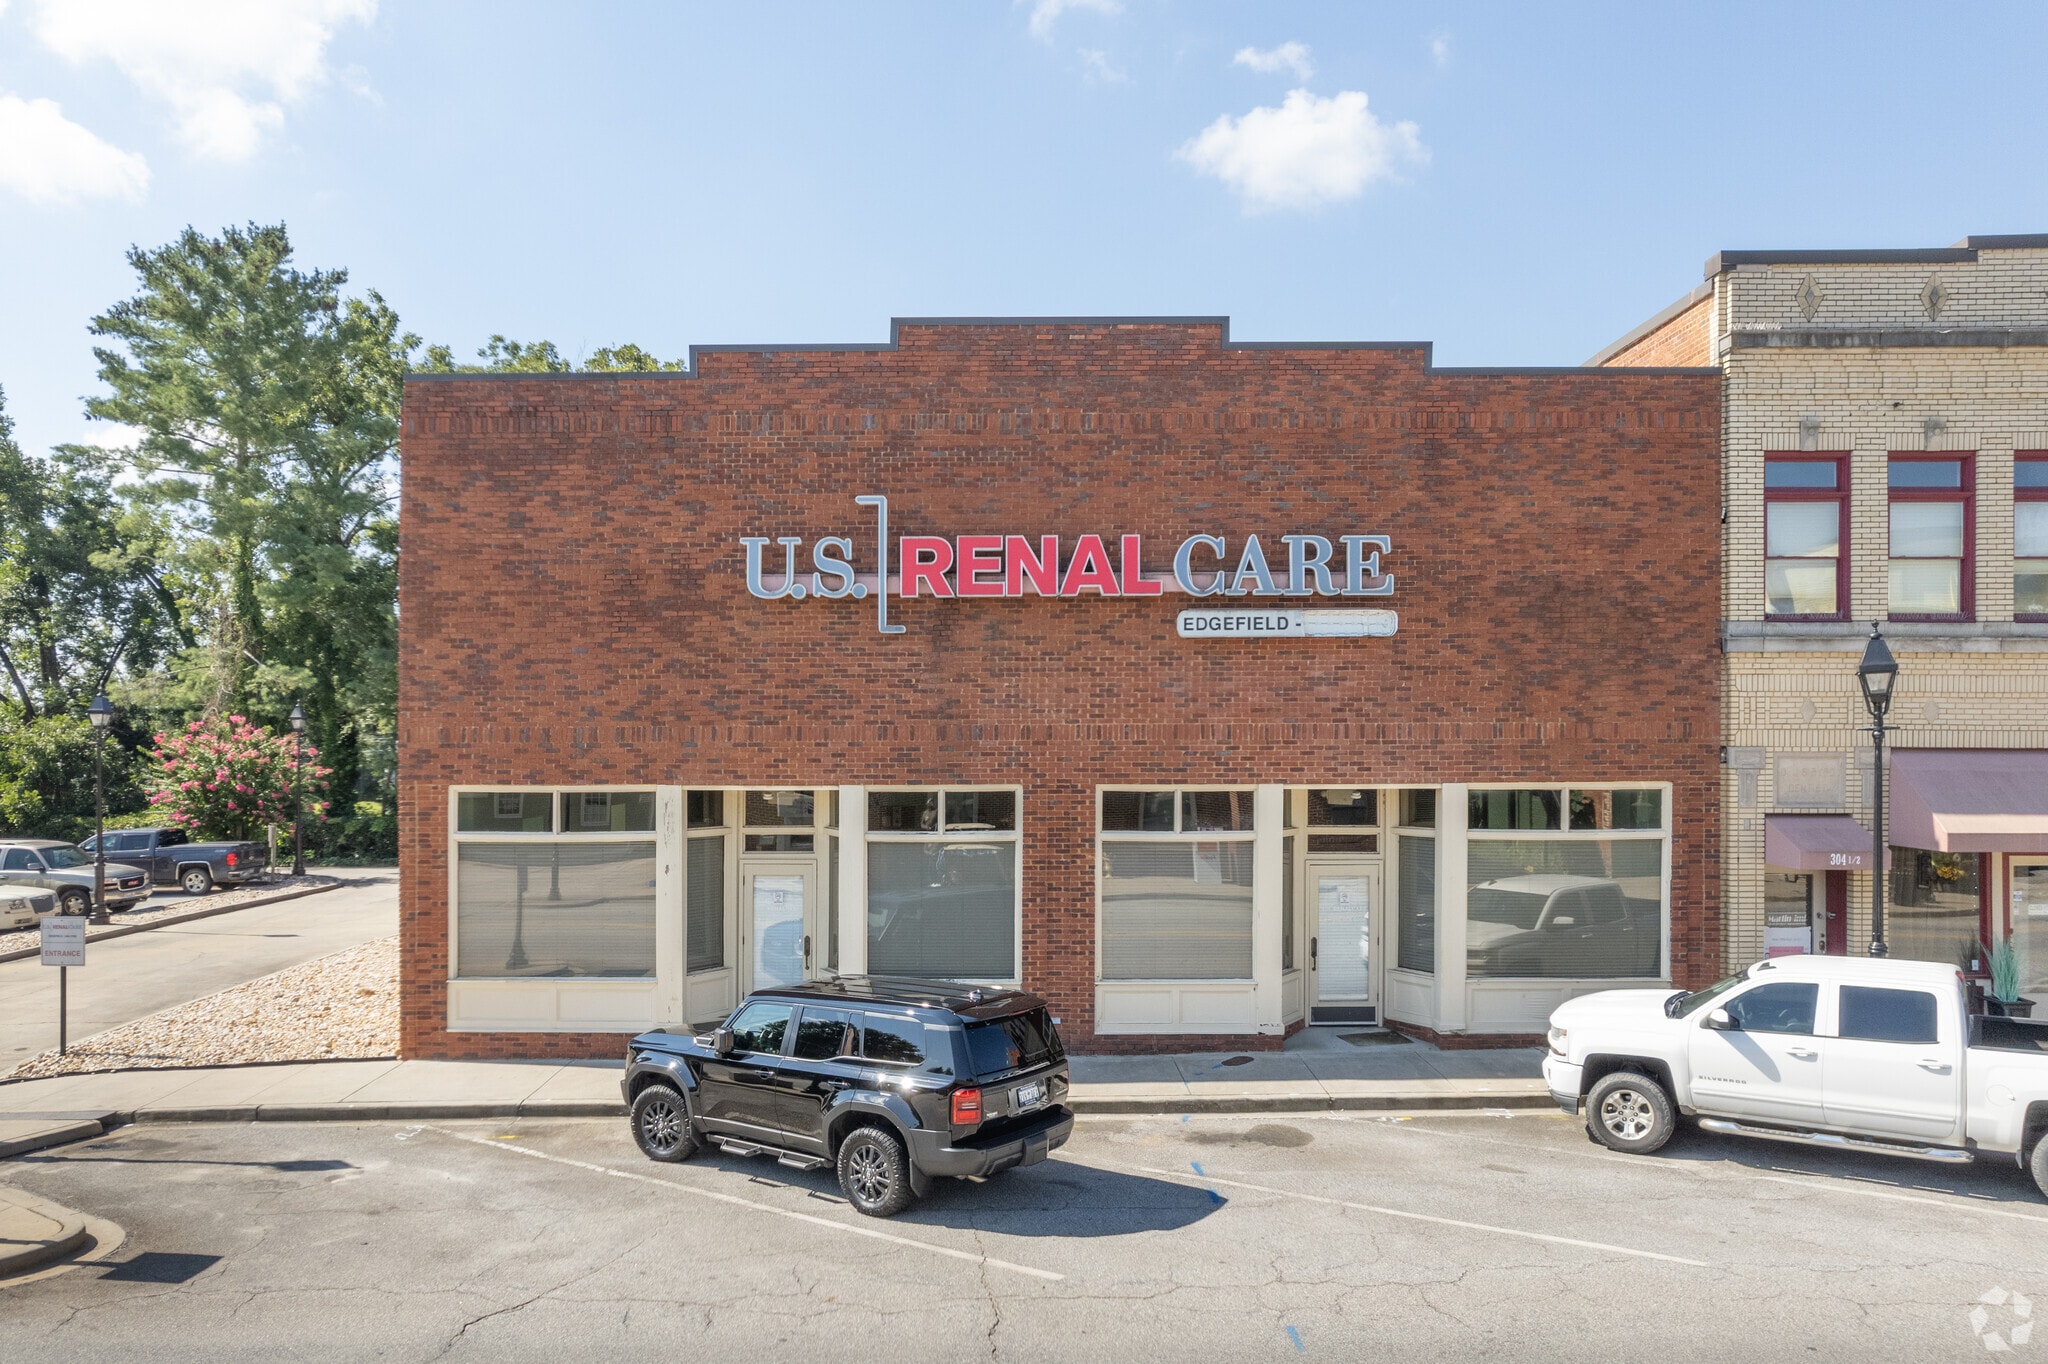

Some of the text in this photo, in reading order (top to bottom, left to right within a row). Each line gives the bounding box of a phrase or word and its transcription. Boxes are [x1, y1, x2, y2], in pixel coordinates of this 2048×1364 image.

[739, 534, 1395, 600] U.S. RENAL CARE
[1183, 616, 1289, 631] EDGEFIELD
[1830, 853, 1861, 866] 304 1/2
